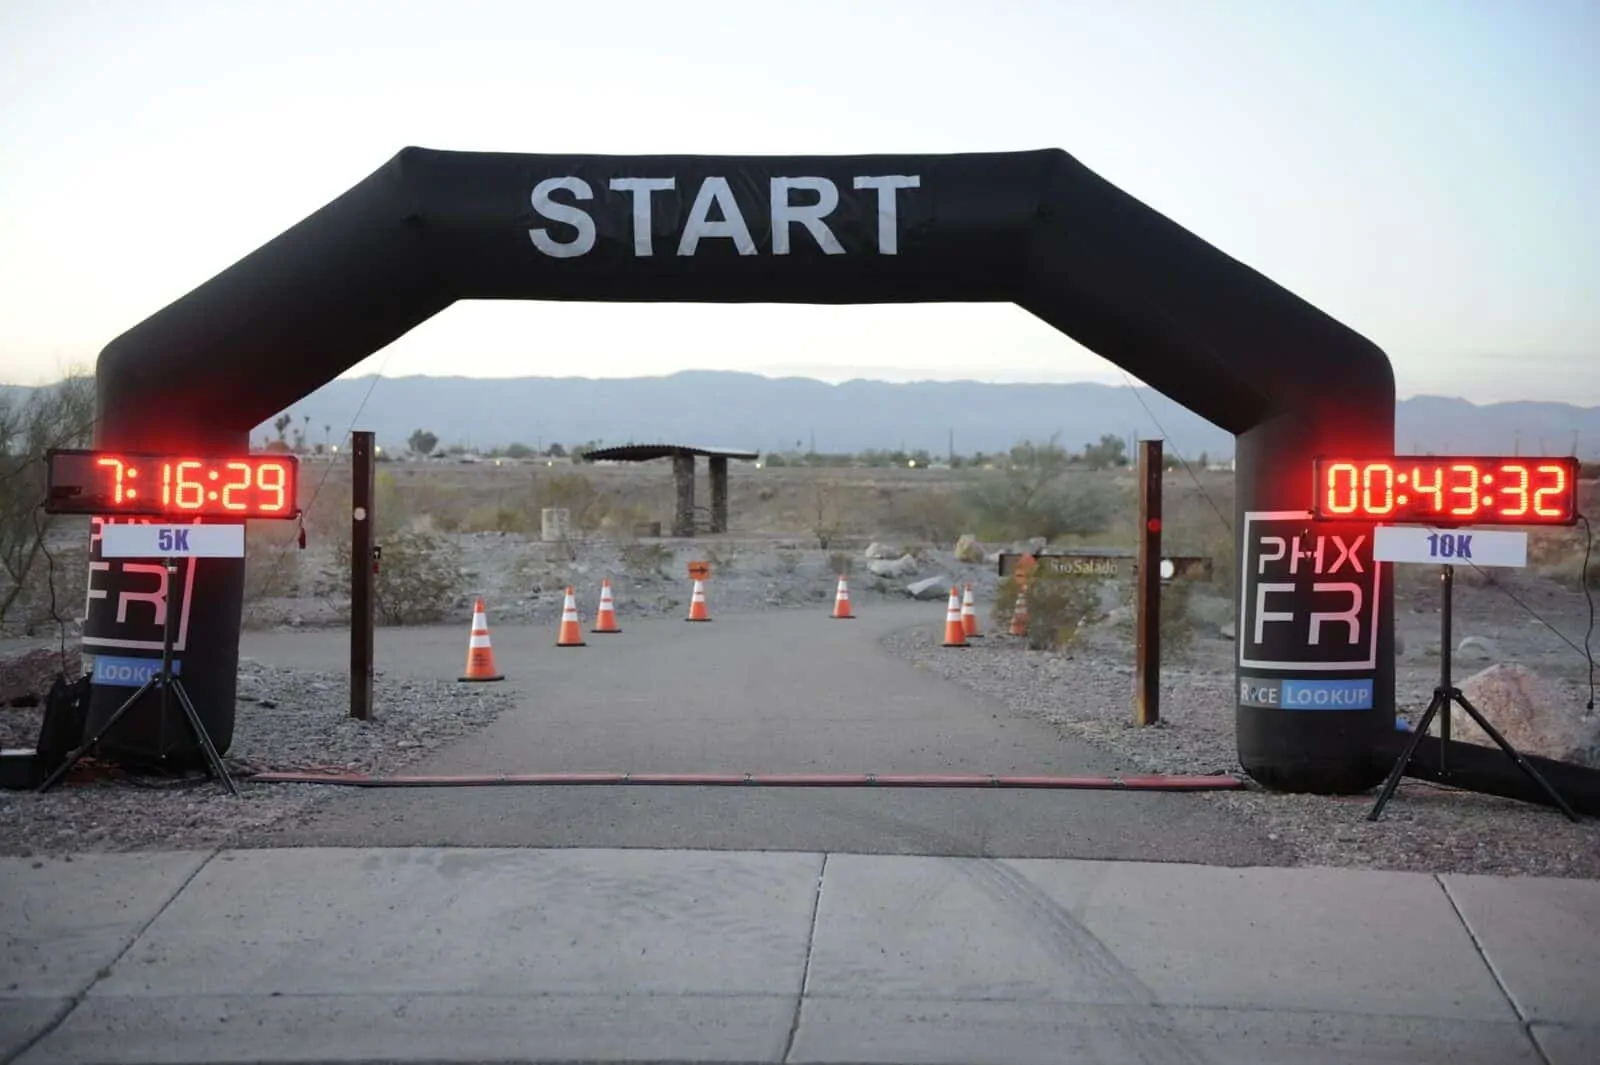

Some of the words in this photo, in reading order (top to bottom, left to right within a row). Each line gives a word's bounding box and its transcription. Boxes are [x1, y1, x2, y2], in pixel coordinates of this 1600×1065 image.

[528, 175, 921, 258] START
[97, 458, 286, 511] 7:16:29
[1327, 463, 1566, 516] 00:43:32
[158, 529, 190, 551] 5K
[1258, 535, 1366, 575] PHX
[1427, 533, 1473, 559] 10K
[85, 561, 168, 626] FR
[1254, 582, 1363, 645] FR
[1286, 685, 1369, 705] LOOKUP
